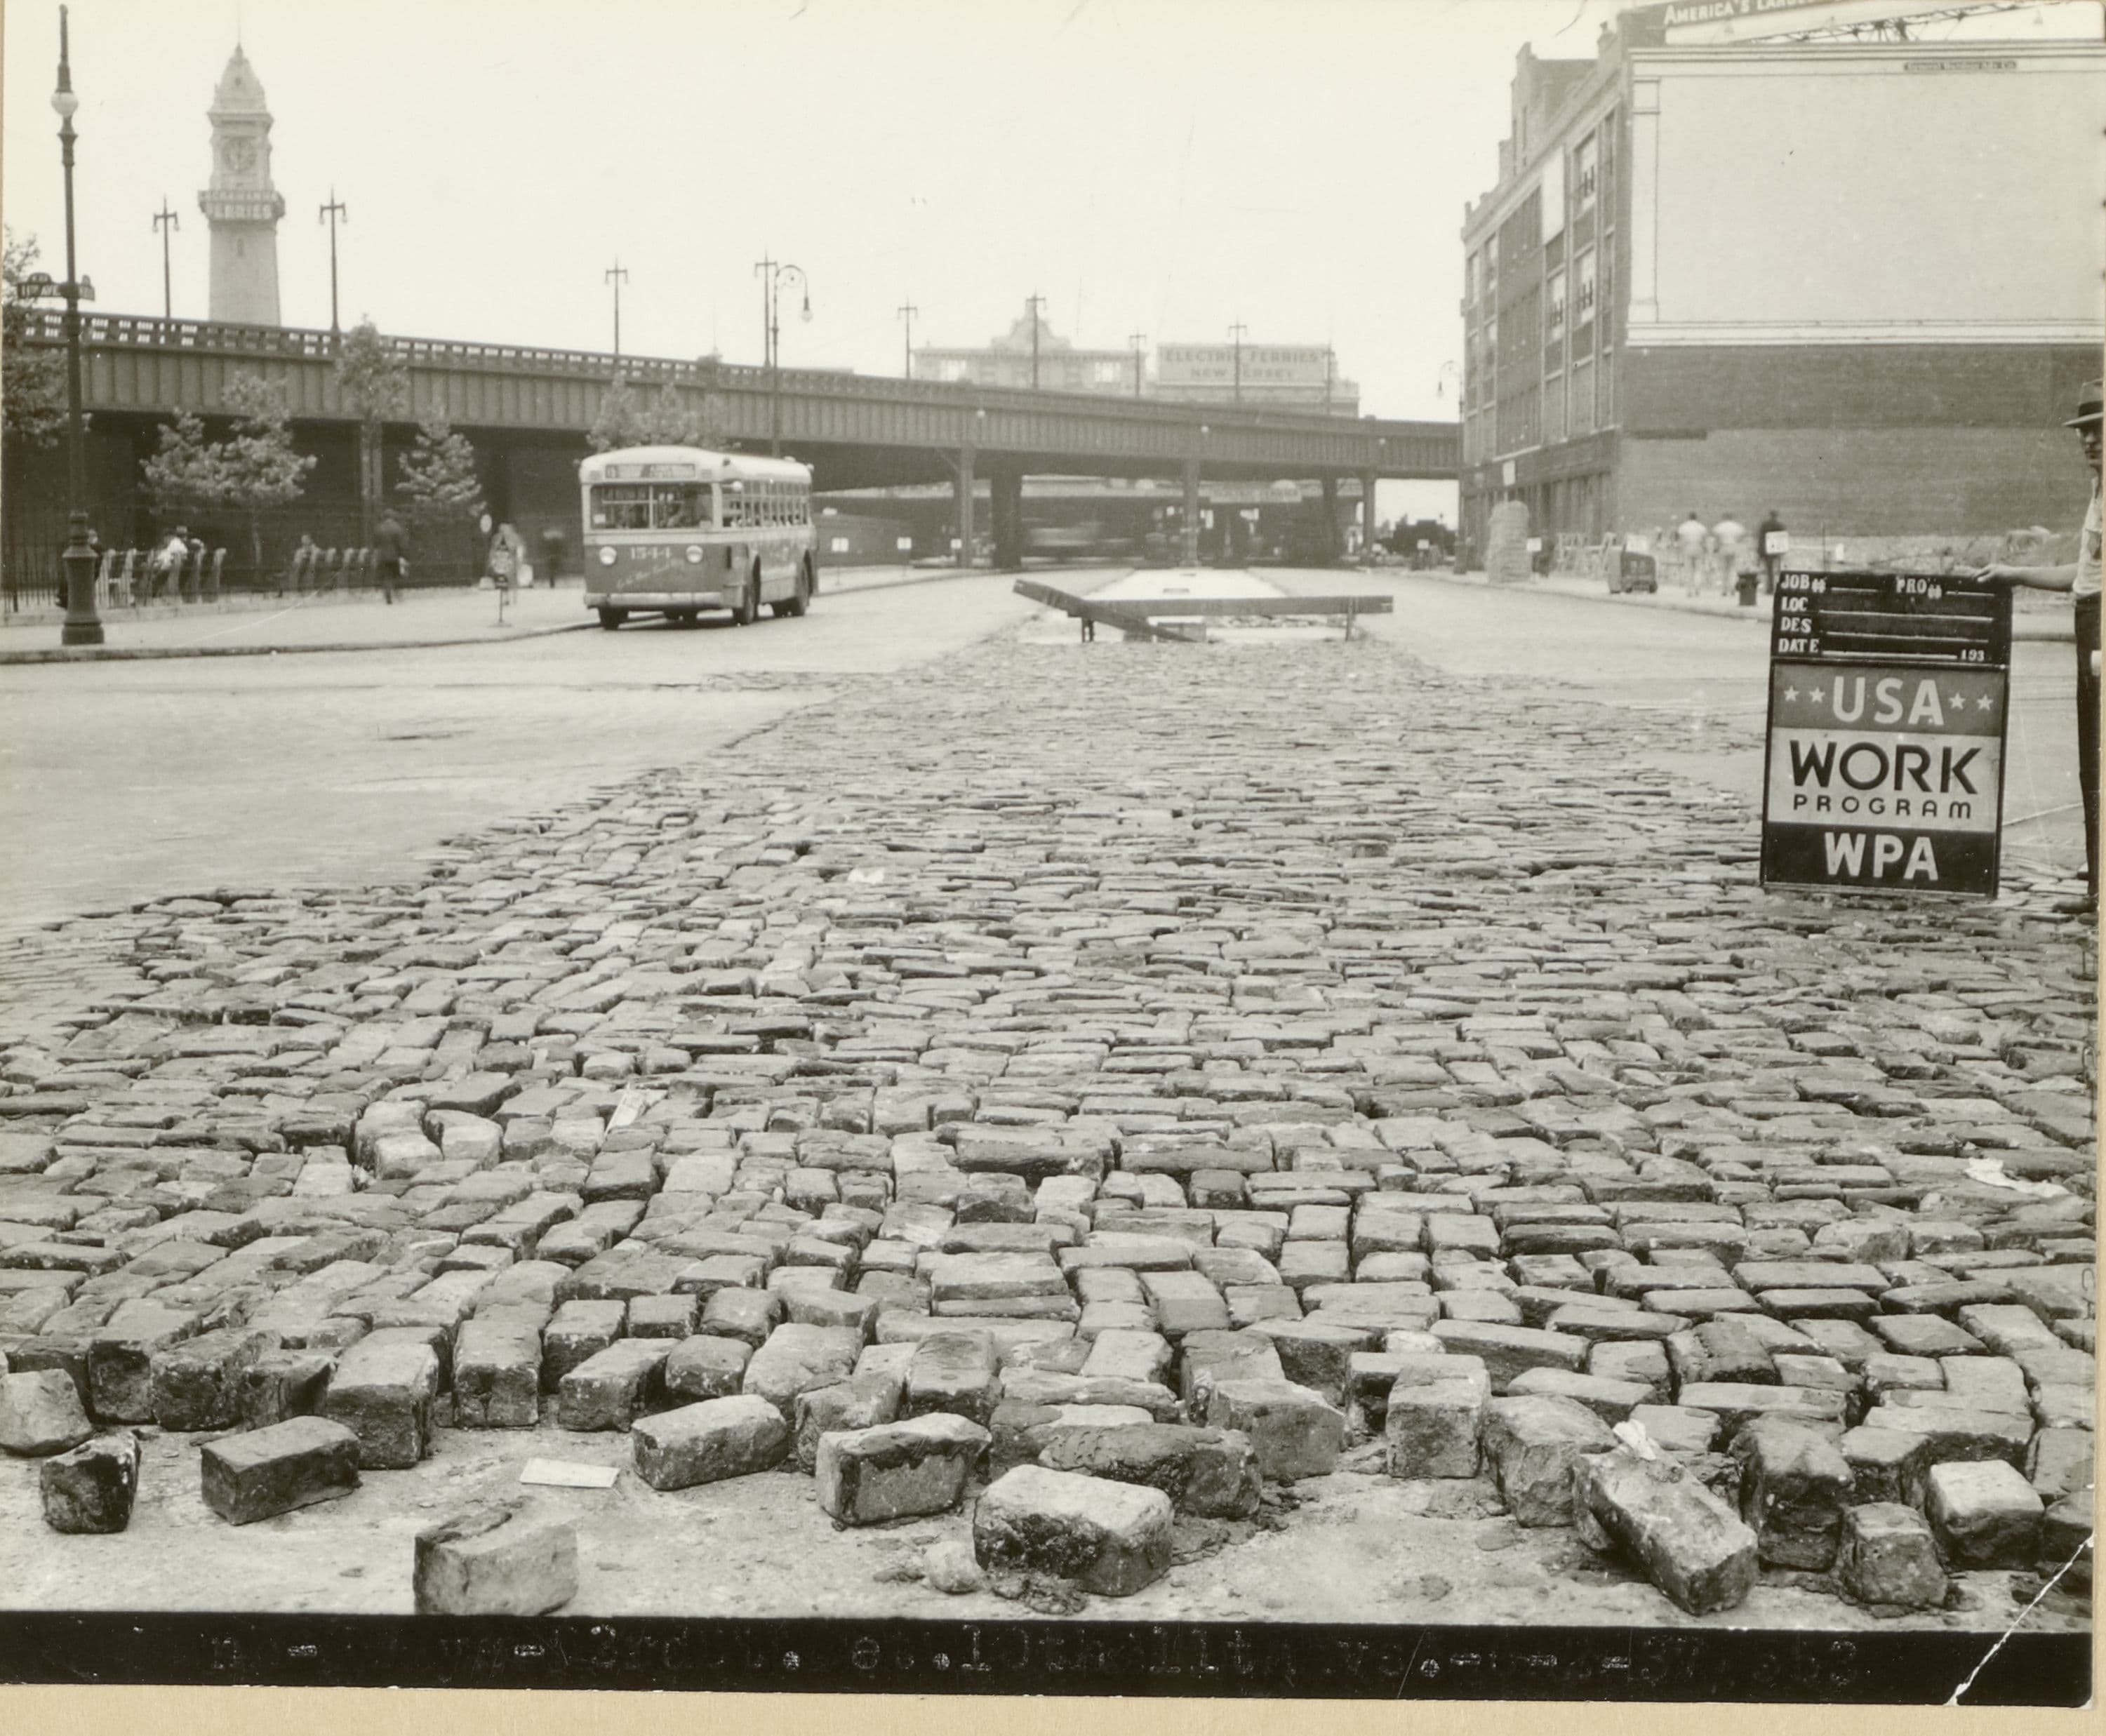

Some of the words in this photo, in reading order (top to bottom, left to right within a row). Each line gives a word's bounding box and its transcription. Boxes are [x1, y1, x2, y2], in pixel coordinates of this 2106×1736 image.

[1663, 0, 1750, 25] AMERICA'S
[1165, 351, 1241, 363] ELECTRI
[1780, 574, 1810, 589] JOB
[1896, 577, 1928, 594] PRO
[1780, 597, 1808, 612] LOC
[1780, 617, 1812, 633] DES
[1778, 638, 1820, 653] DATE
[1961, 650, 1985, 661] 193
[1832, 676, 1945, 726] USA
[1790, 740, 1982, 794] WORK
[1793, 794, 1971, 819] PROGRAM
[1825, 832, 1939, 881] WPA
